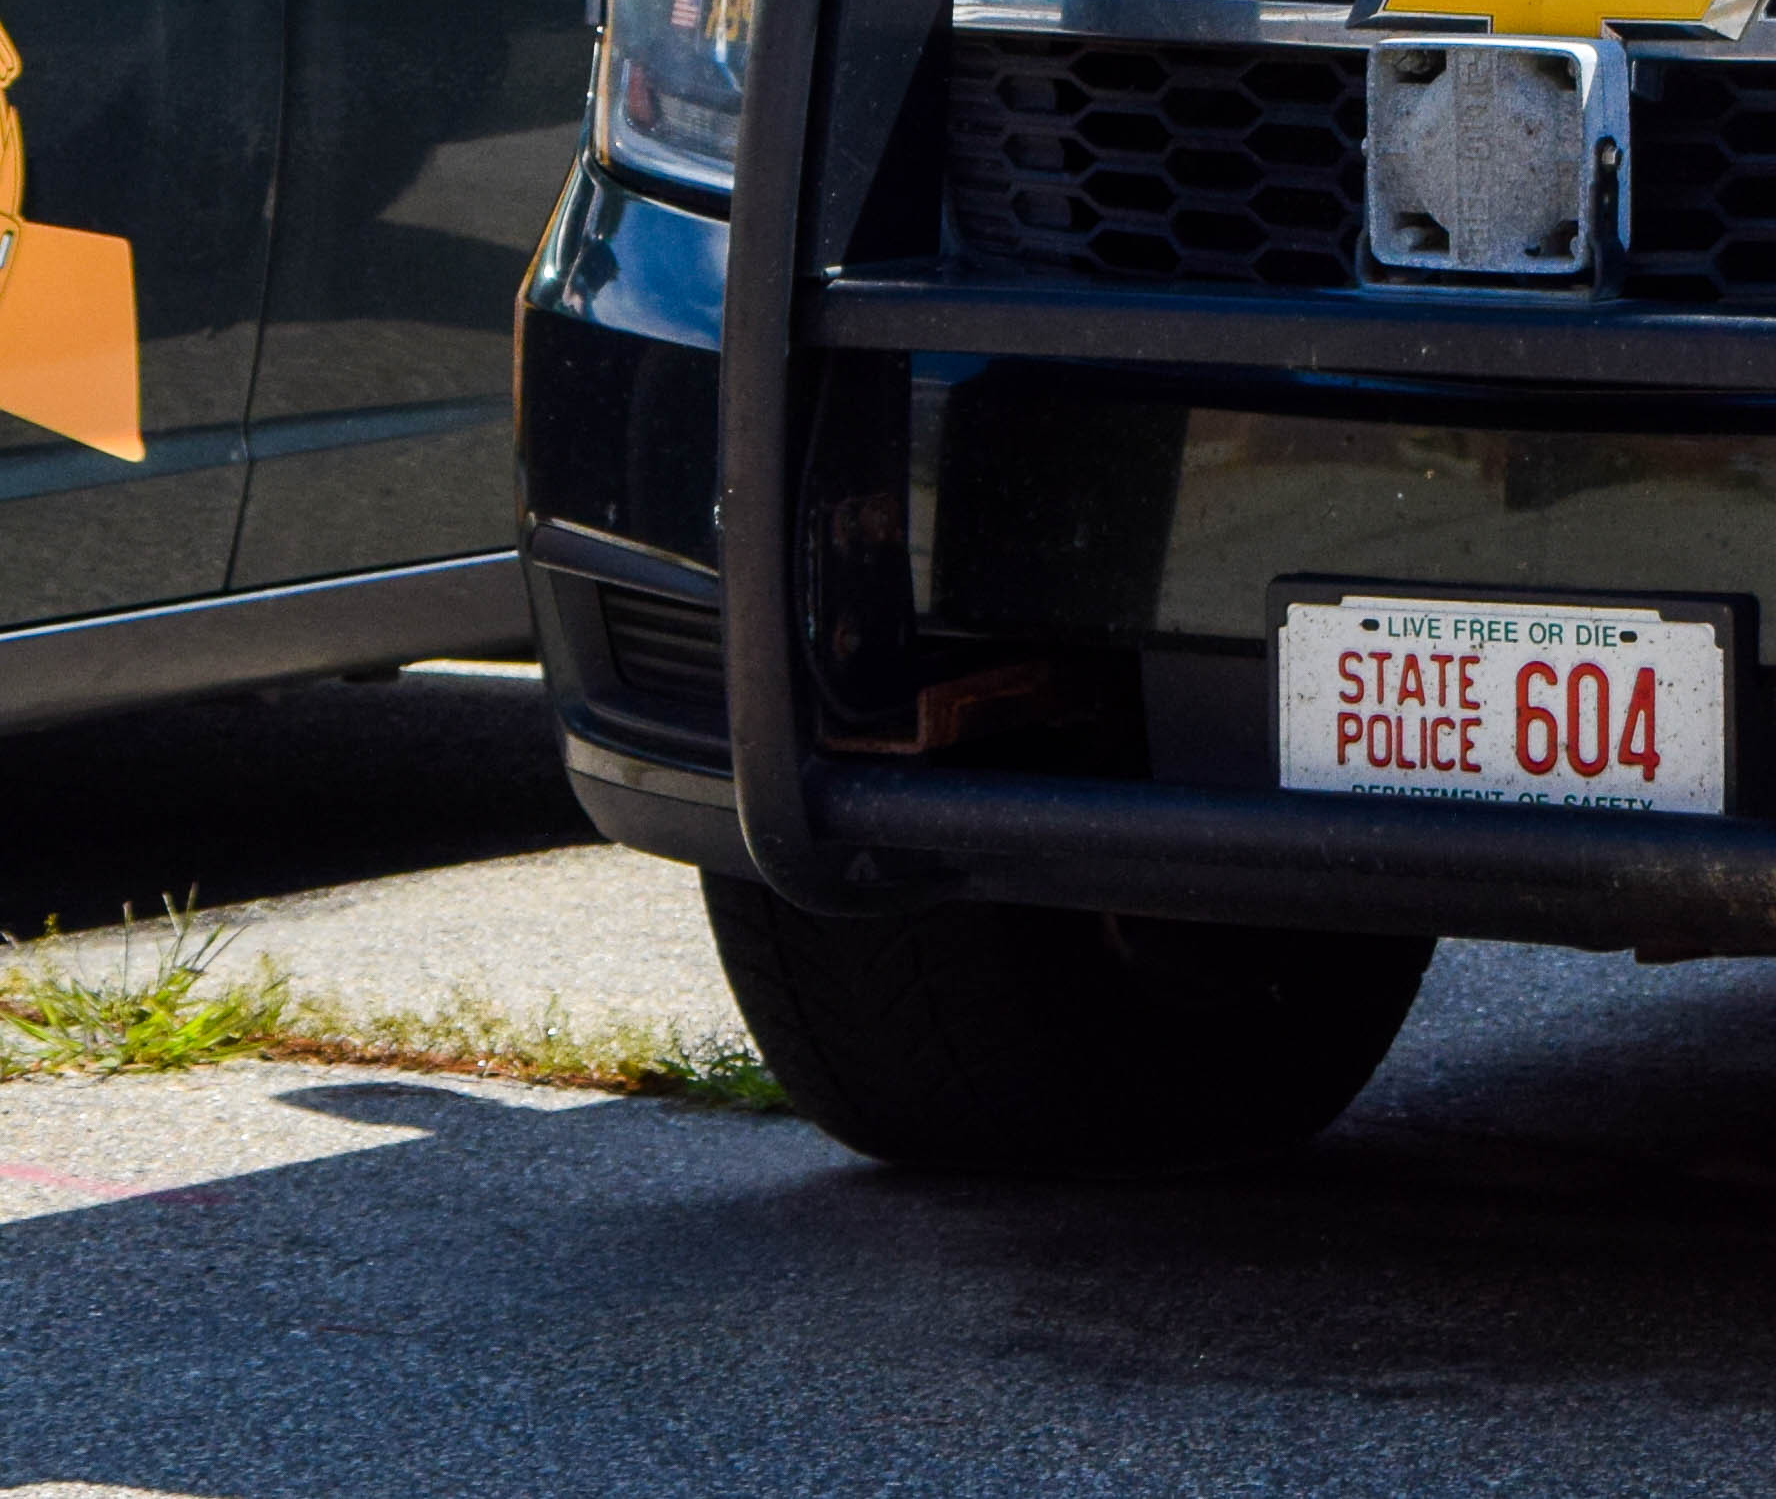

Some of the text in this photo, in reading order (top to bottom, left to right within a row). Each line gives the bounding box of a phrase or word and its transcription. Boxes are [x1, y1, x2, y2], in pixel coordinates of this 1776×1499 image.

[1387, 616, 1618, 647] LIVE FREE OR DIE
[1337, 650, 1481, 711] STATE
[1337, 711, 1481, 774] POLICE
[1514, 660, 1661, 782] 604
